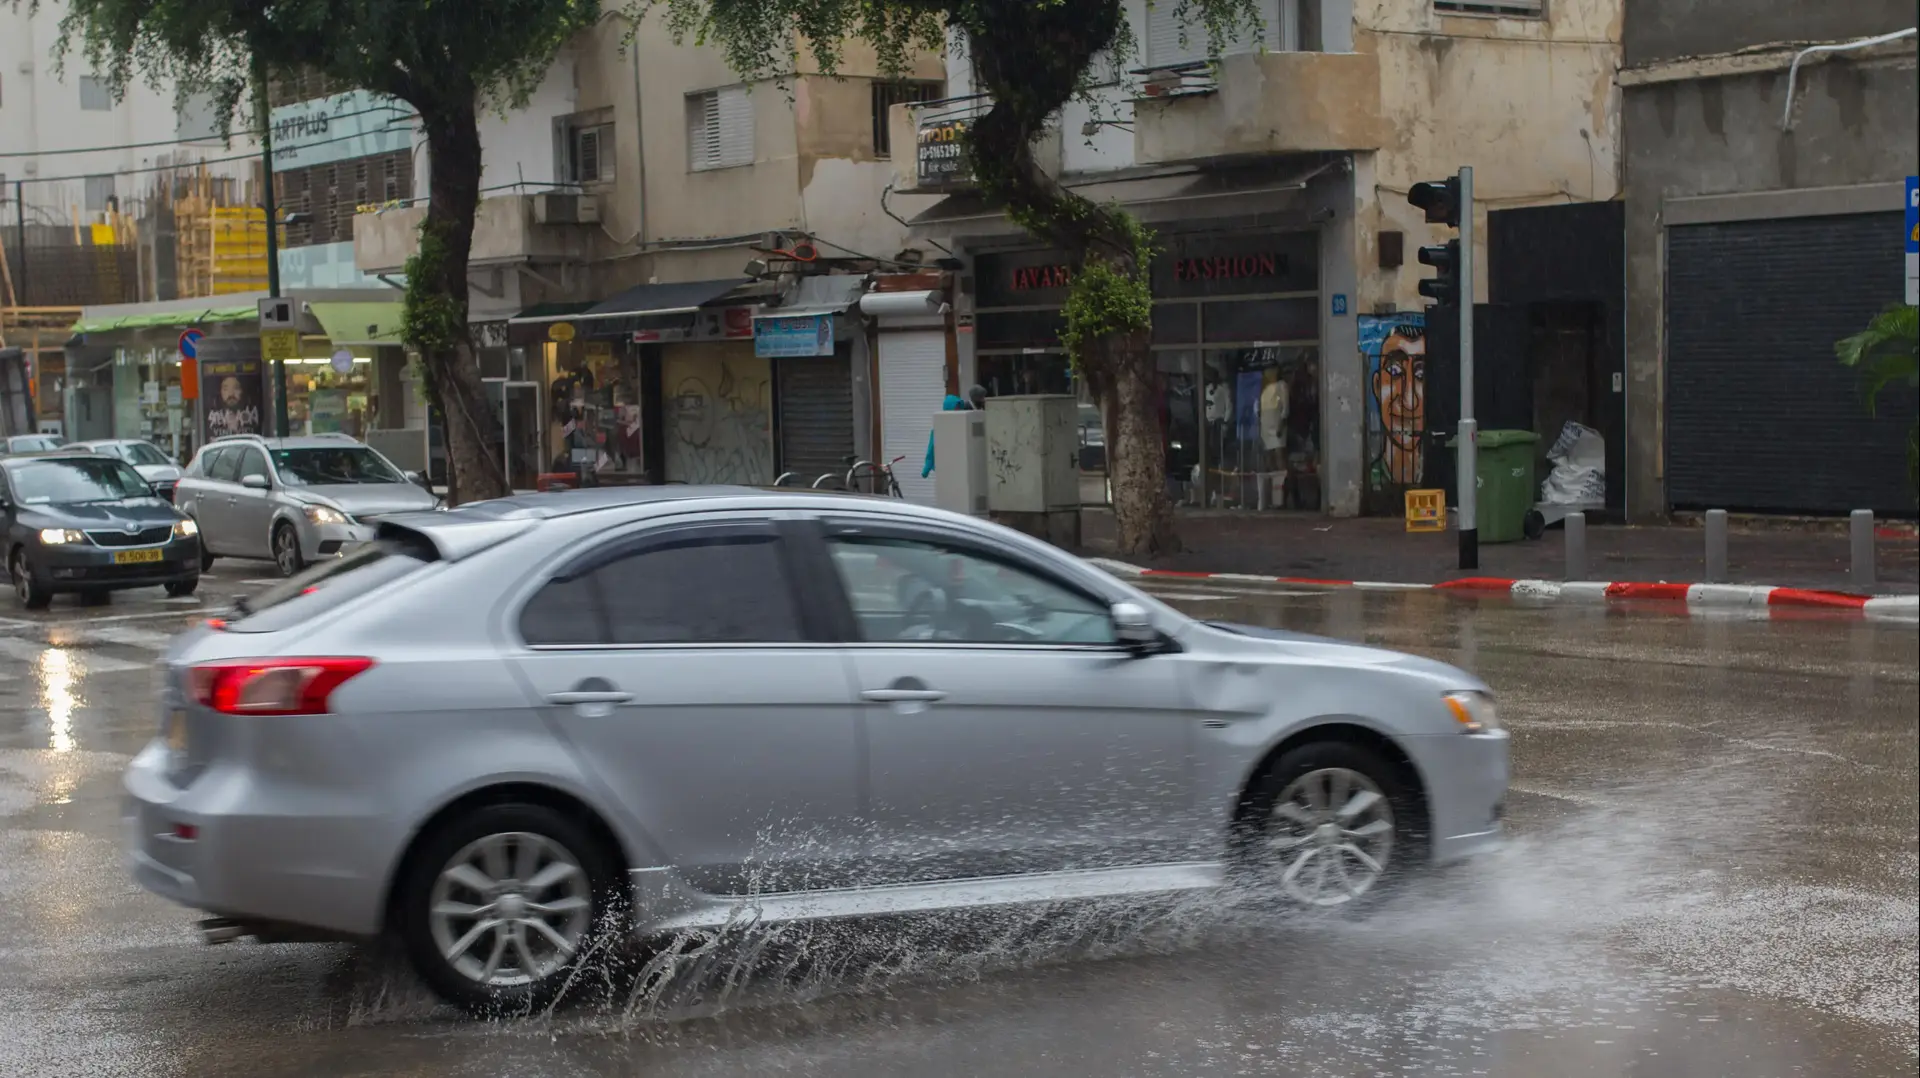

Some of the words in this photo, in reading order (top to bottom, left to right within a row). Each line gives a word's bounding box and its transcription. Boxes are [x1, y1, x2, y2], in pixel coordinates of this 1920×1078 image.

[275, 111, 329, 142] ARTPLUS
[941, 161, 958, 171] sale
[1172, 252, 1275, 282] FASHION
[1334, 298, 1346, 312] 39
